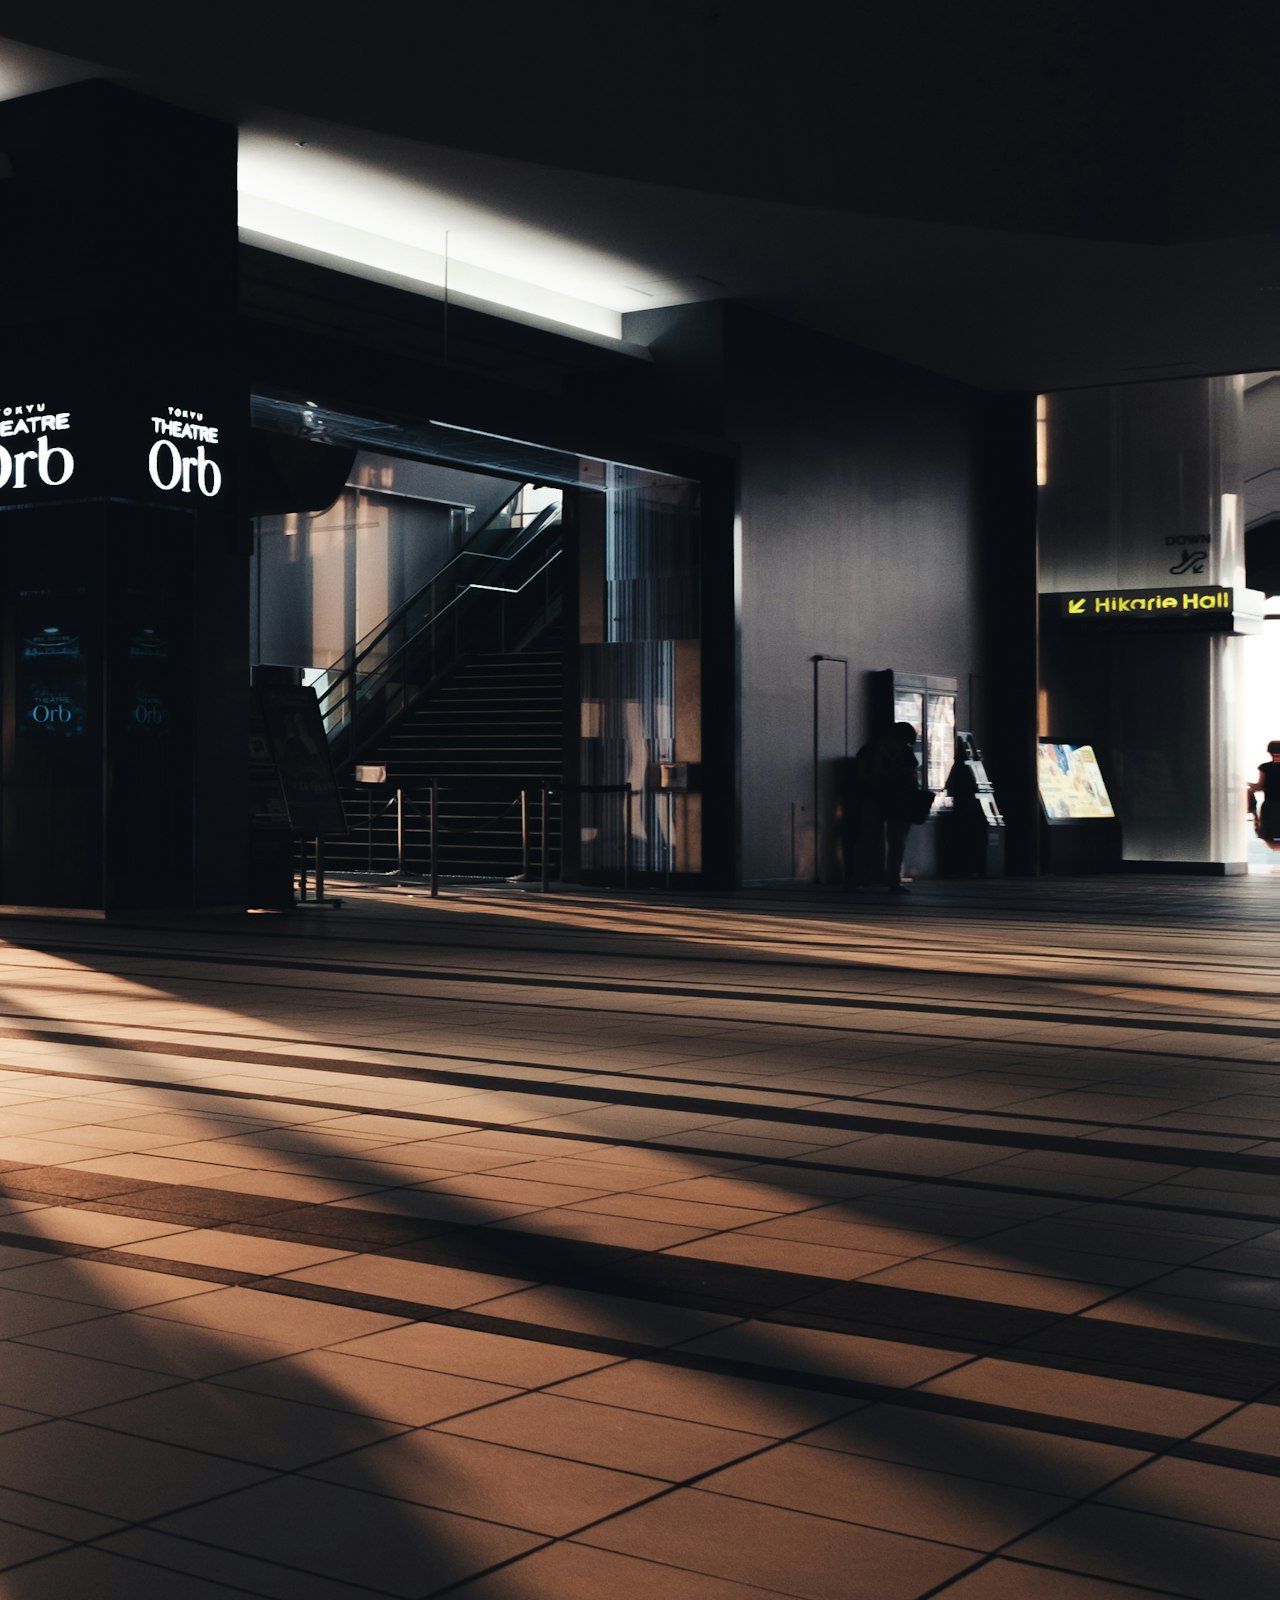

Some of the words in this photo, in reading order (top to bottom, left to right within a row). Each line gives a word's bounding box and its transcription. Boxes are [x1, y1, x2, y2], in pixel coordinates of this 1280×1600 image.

[150, 416, 219, 444] THEATRE
[148, 439, 222, 497] Orb
[1165, 534, 1210, 546] DOWN
[1095, 597, 1178, 613] Hikarie
[1183, 592, 1229, 609] Hall
[32, 703, 73, 724] Orb
[135, 703, 163, 725] Orb
